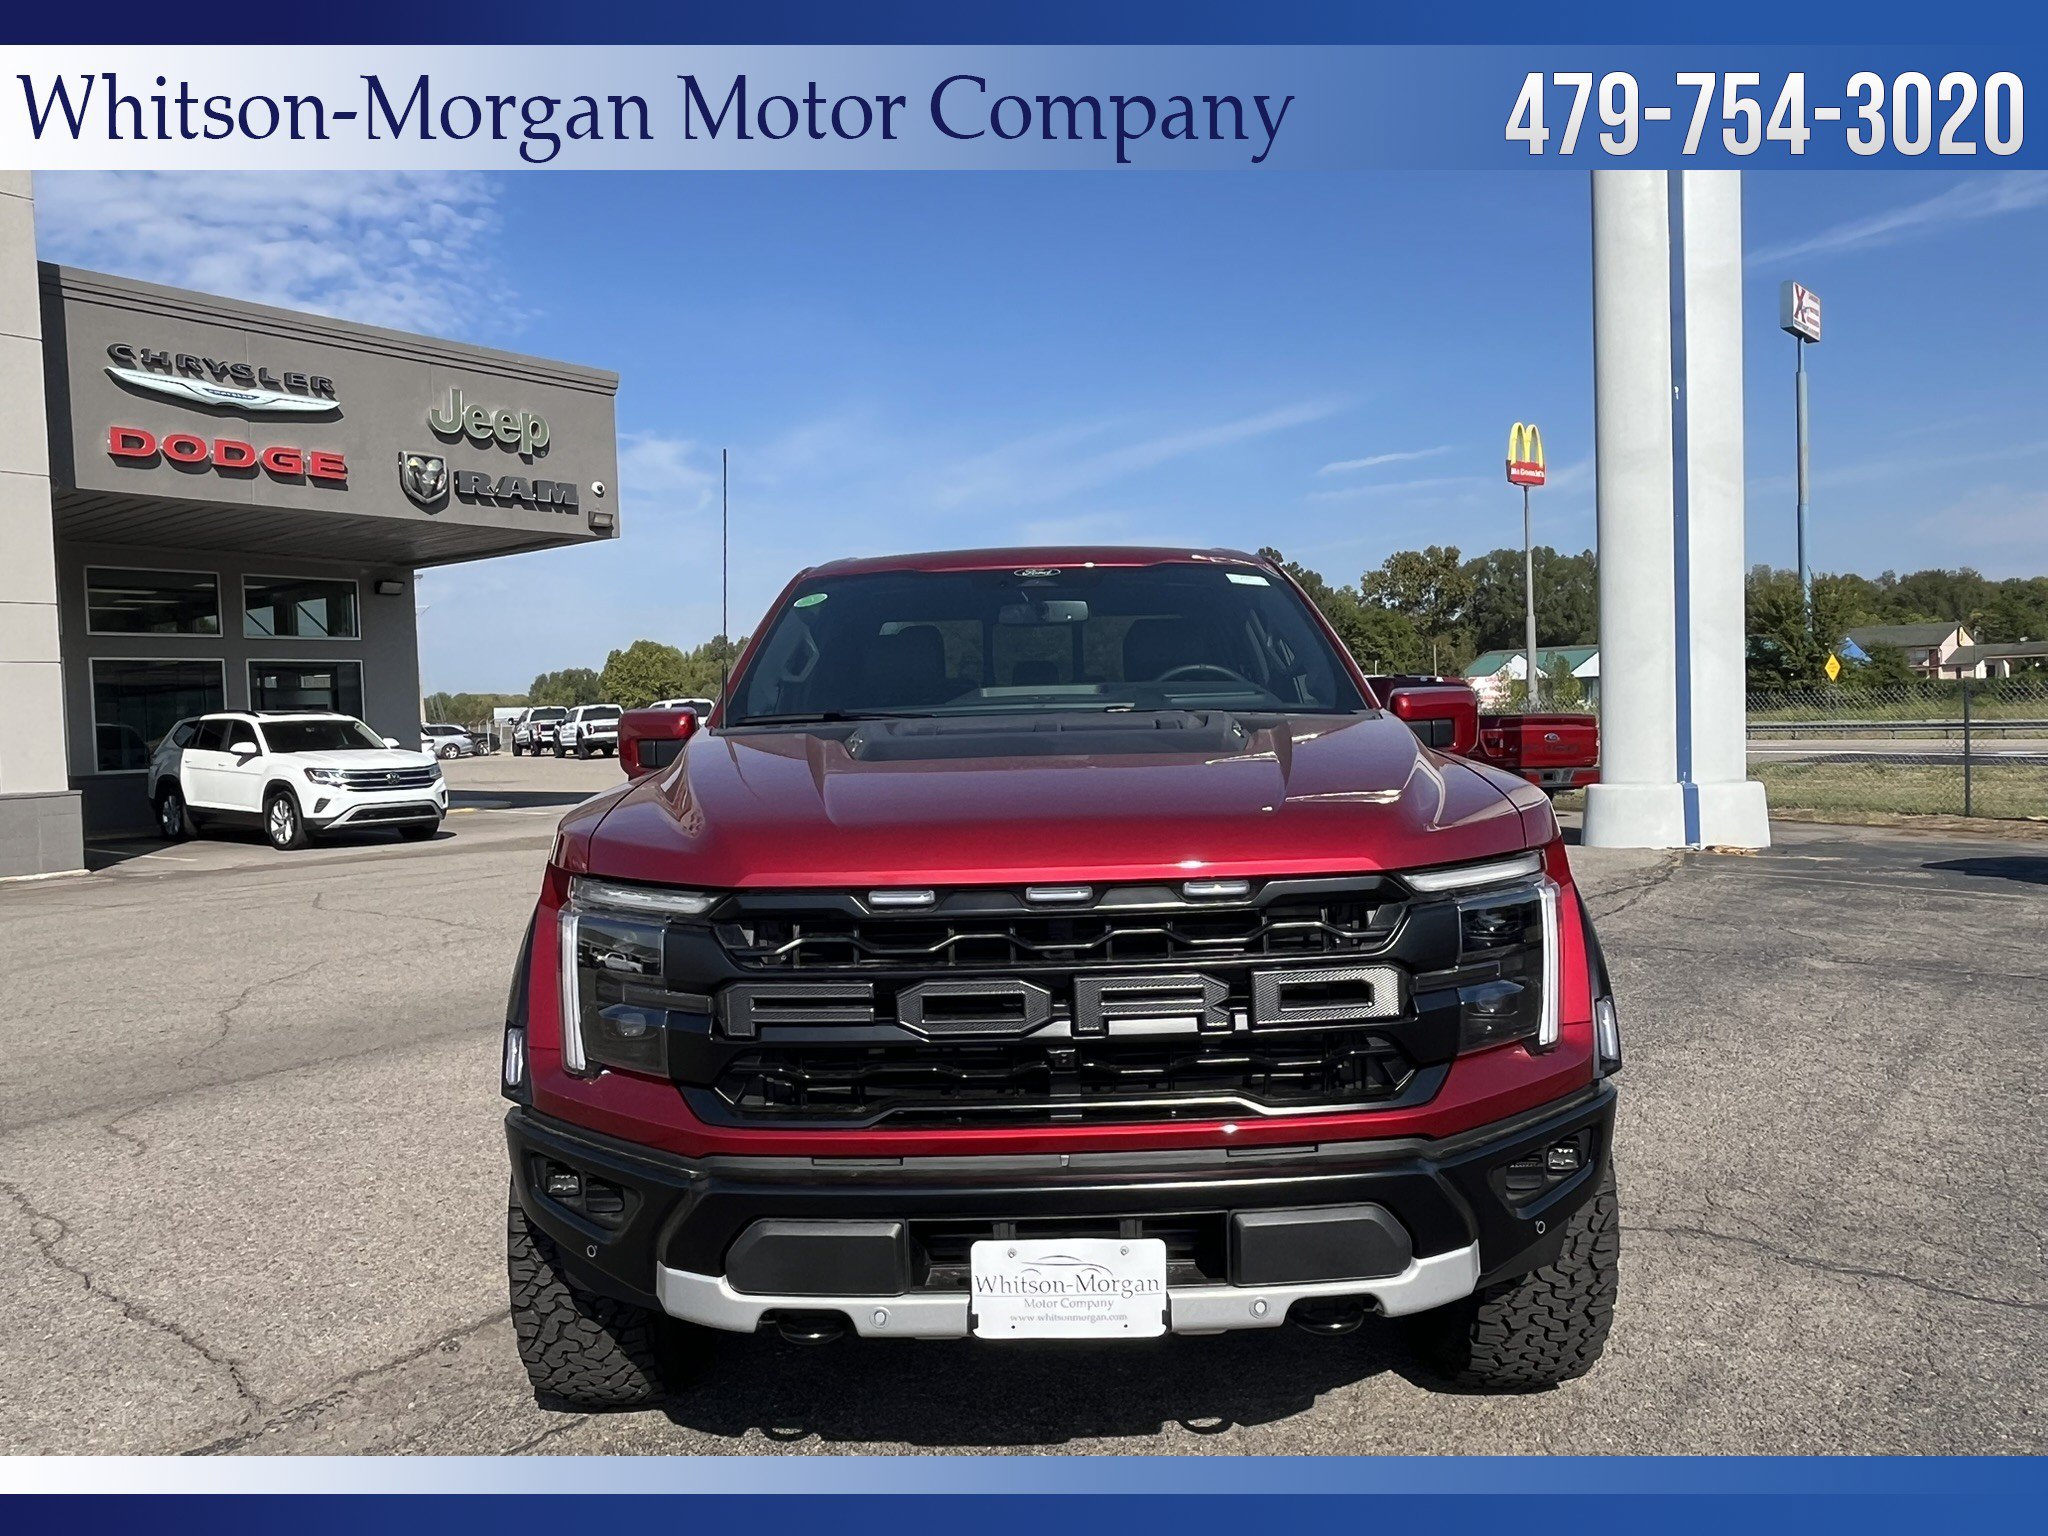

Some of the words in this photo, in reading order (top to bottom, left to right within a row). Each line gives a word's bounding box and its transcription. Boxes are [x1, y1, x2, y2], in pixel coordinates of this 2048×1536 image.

[107, 343, 335, 392] CHRYSLER
[430, 387, 550, 455] Jeep
[109, 426, 348, 480] DODGE
[453, 470, 579, 505] RAM
[724, 965, 1401, 1041] FORD
[974, 1273, 1160, 1299] Whitson-Morgan
[1024, 1298, 1058, 1309] Motor
[1060, 1297, 1114, 1310] Company
[1010, 1313, 1128, 1323] www.whitsonmorgan.com
